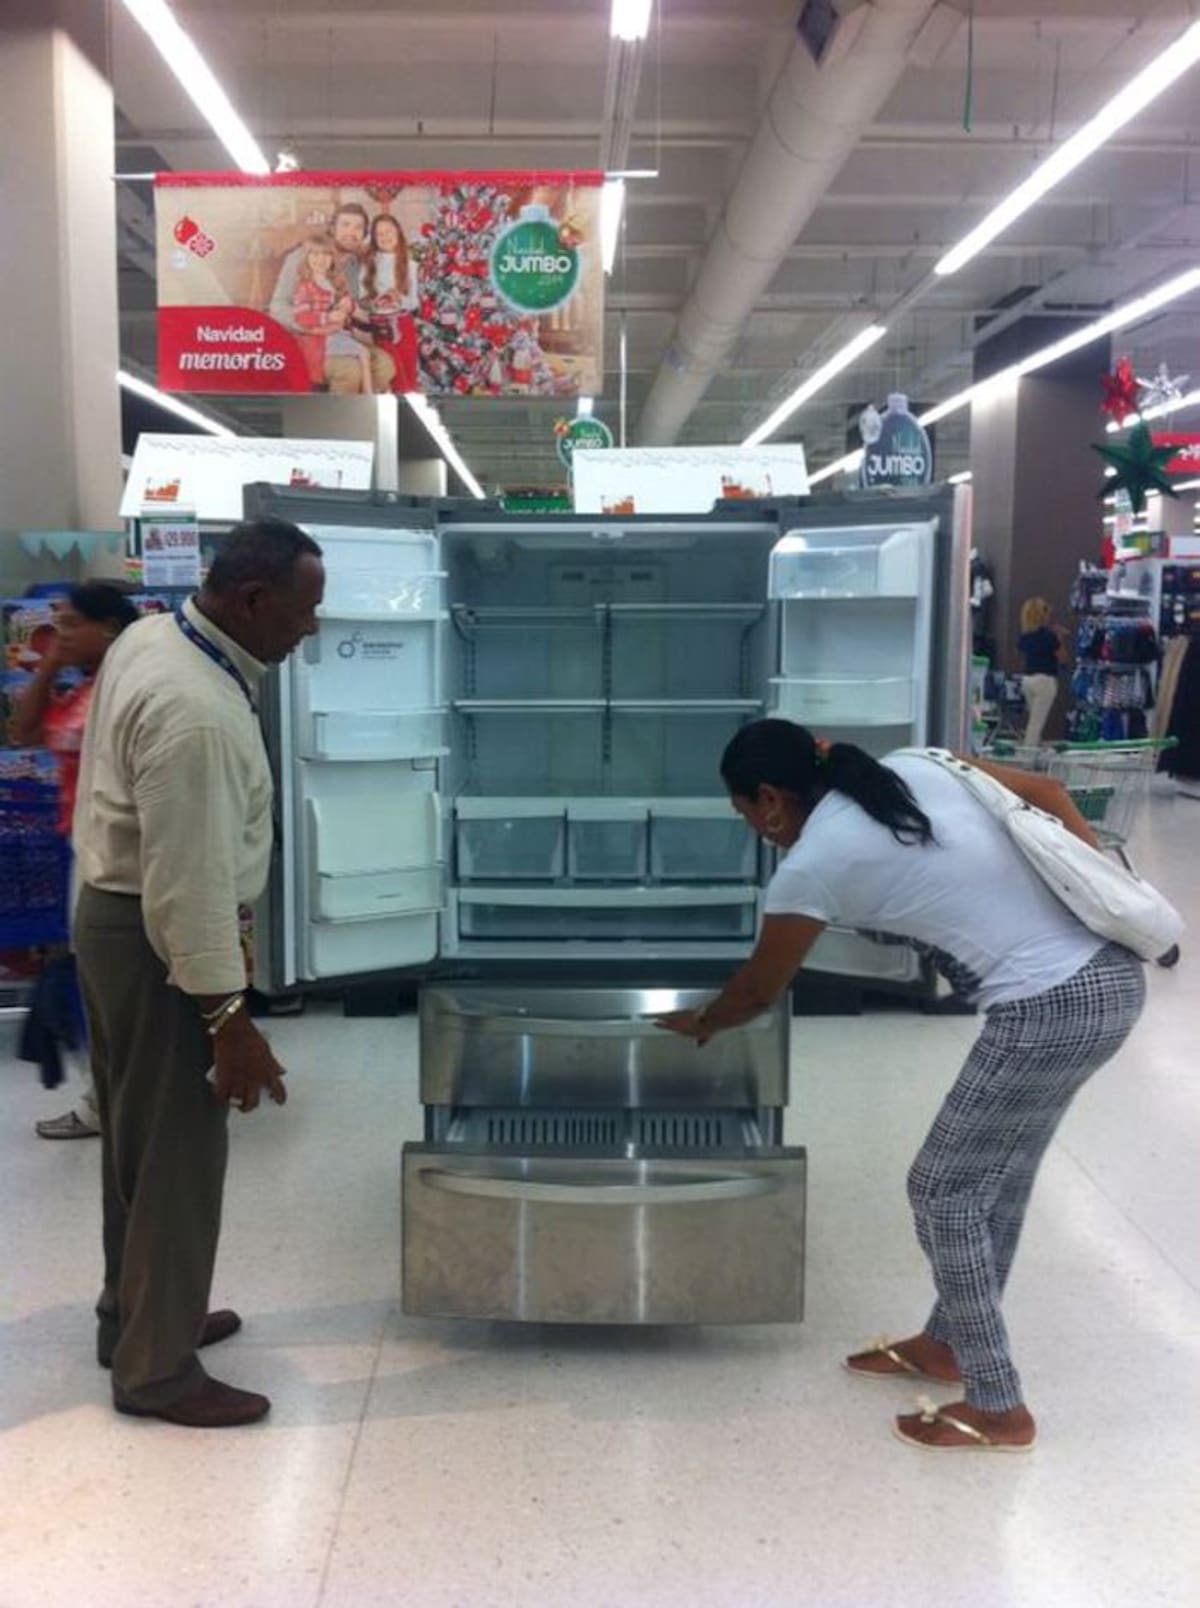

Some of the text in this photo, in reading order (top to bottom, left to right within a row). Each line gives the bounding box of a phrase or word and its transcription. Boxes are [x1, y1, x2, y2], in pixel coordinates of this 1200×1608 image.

[499, 255, 572, 273] JUMBO
[196, 325, 265, 342] Navidad
[179, 347, 285, 370] memories
[867, 454, 925, 475] JUMBO
